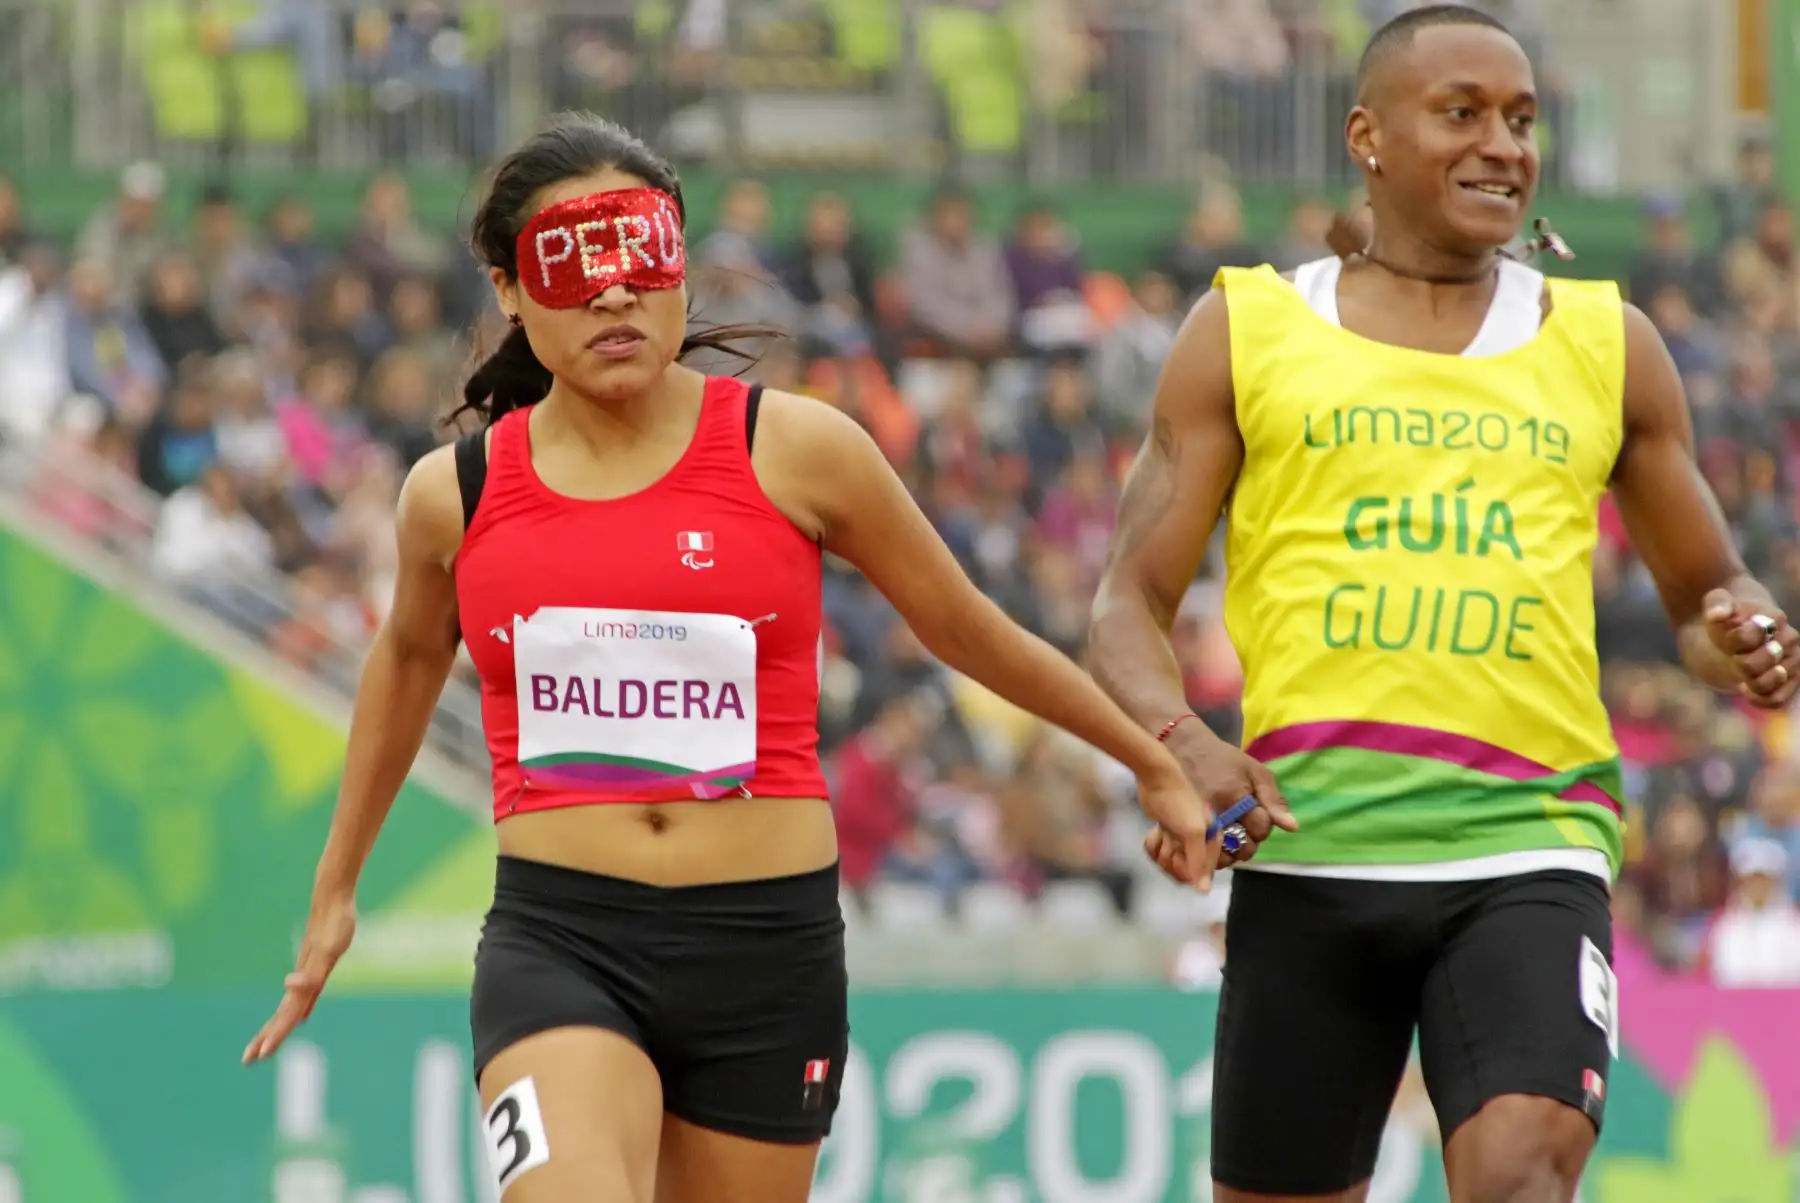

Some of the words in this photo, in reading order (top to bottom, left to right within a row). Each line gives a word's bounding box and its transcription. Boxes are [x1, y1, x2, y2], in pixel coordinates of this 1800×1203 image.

[536, 198, 679, 287] PERÚ
[1344, 477, 1523, 560] GUÍA
[1323, 583, 1544, 661] GUIDE
[531, 674, 745, 720] BALDERA
[489, 1097, 531, 1186] 3
